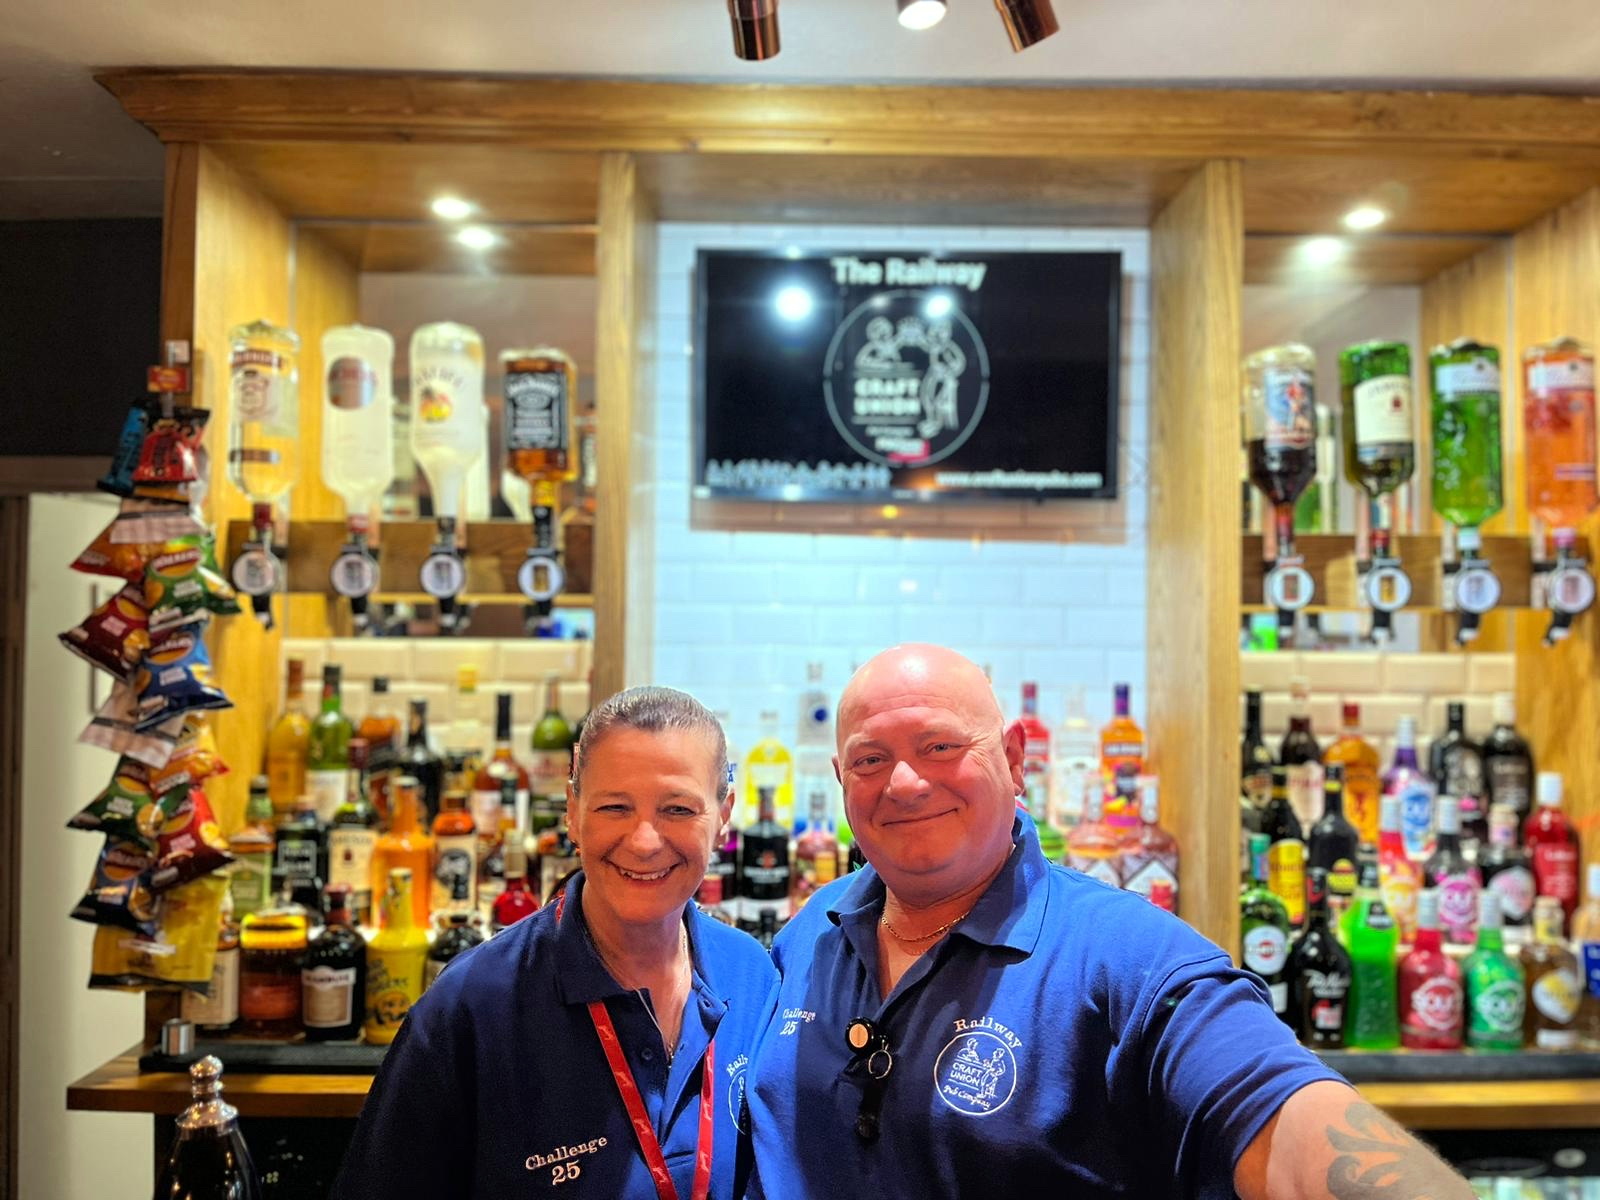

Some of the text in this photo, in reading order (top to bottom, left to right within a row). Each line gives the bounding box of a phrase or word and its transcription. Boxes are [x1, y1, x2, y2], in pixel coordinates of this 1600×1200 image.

[830, 256, 988, 291] The Railway
[782, 1008, 816, 1023] Challenge
[780, 1021, 798, 1035] 25
[953, 1016, 1022, 1048] Railway
[950, 1070, 981, 1087] UNION
[952, 1062, 983, 1078] CRAFT
[525, 1136, 608, 1170] Challenge
[552, 1159, 580, 1186] 25
